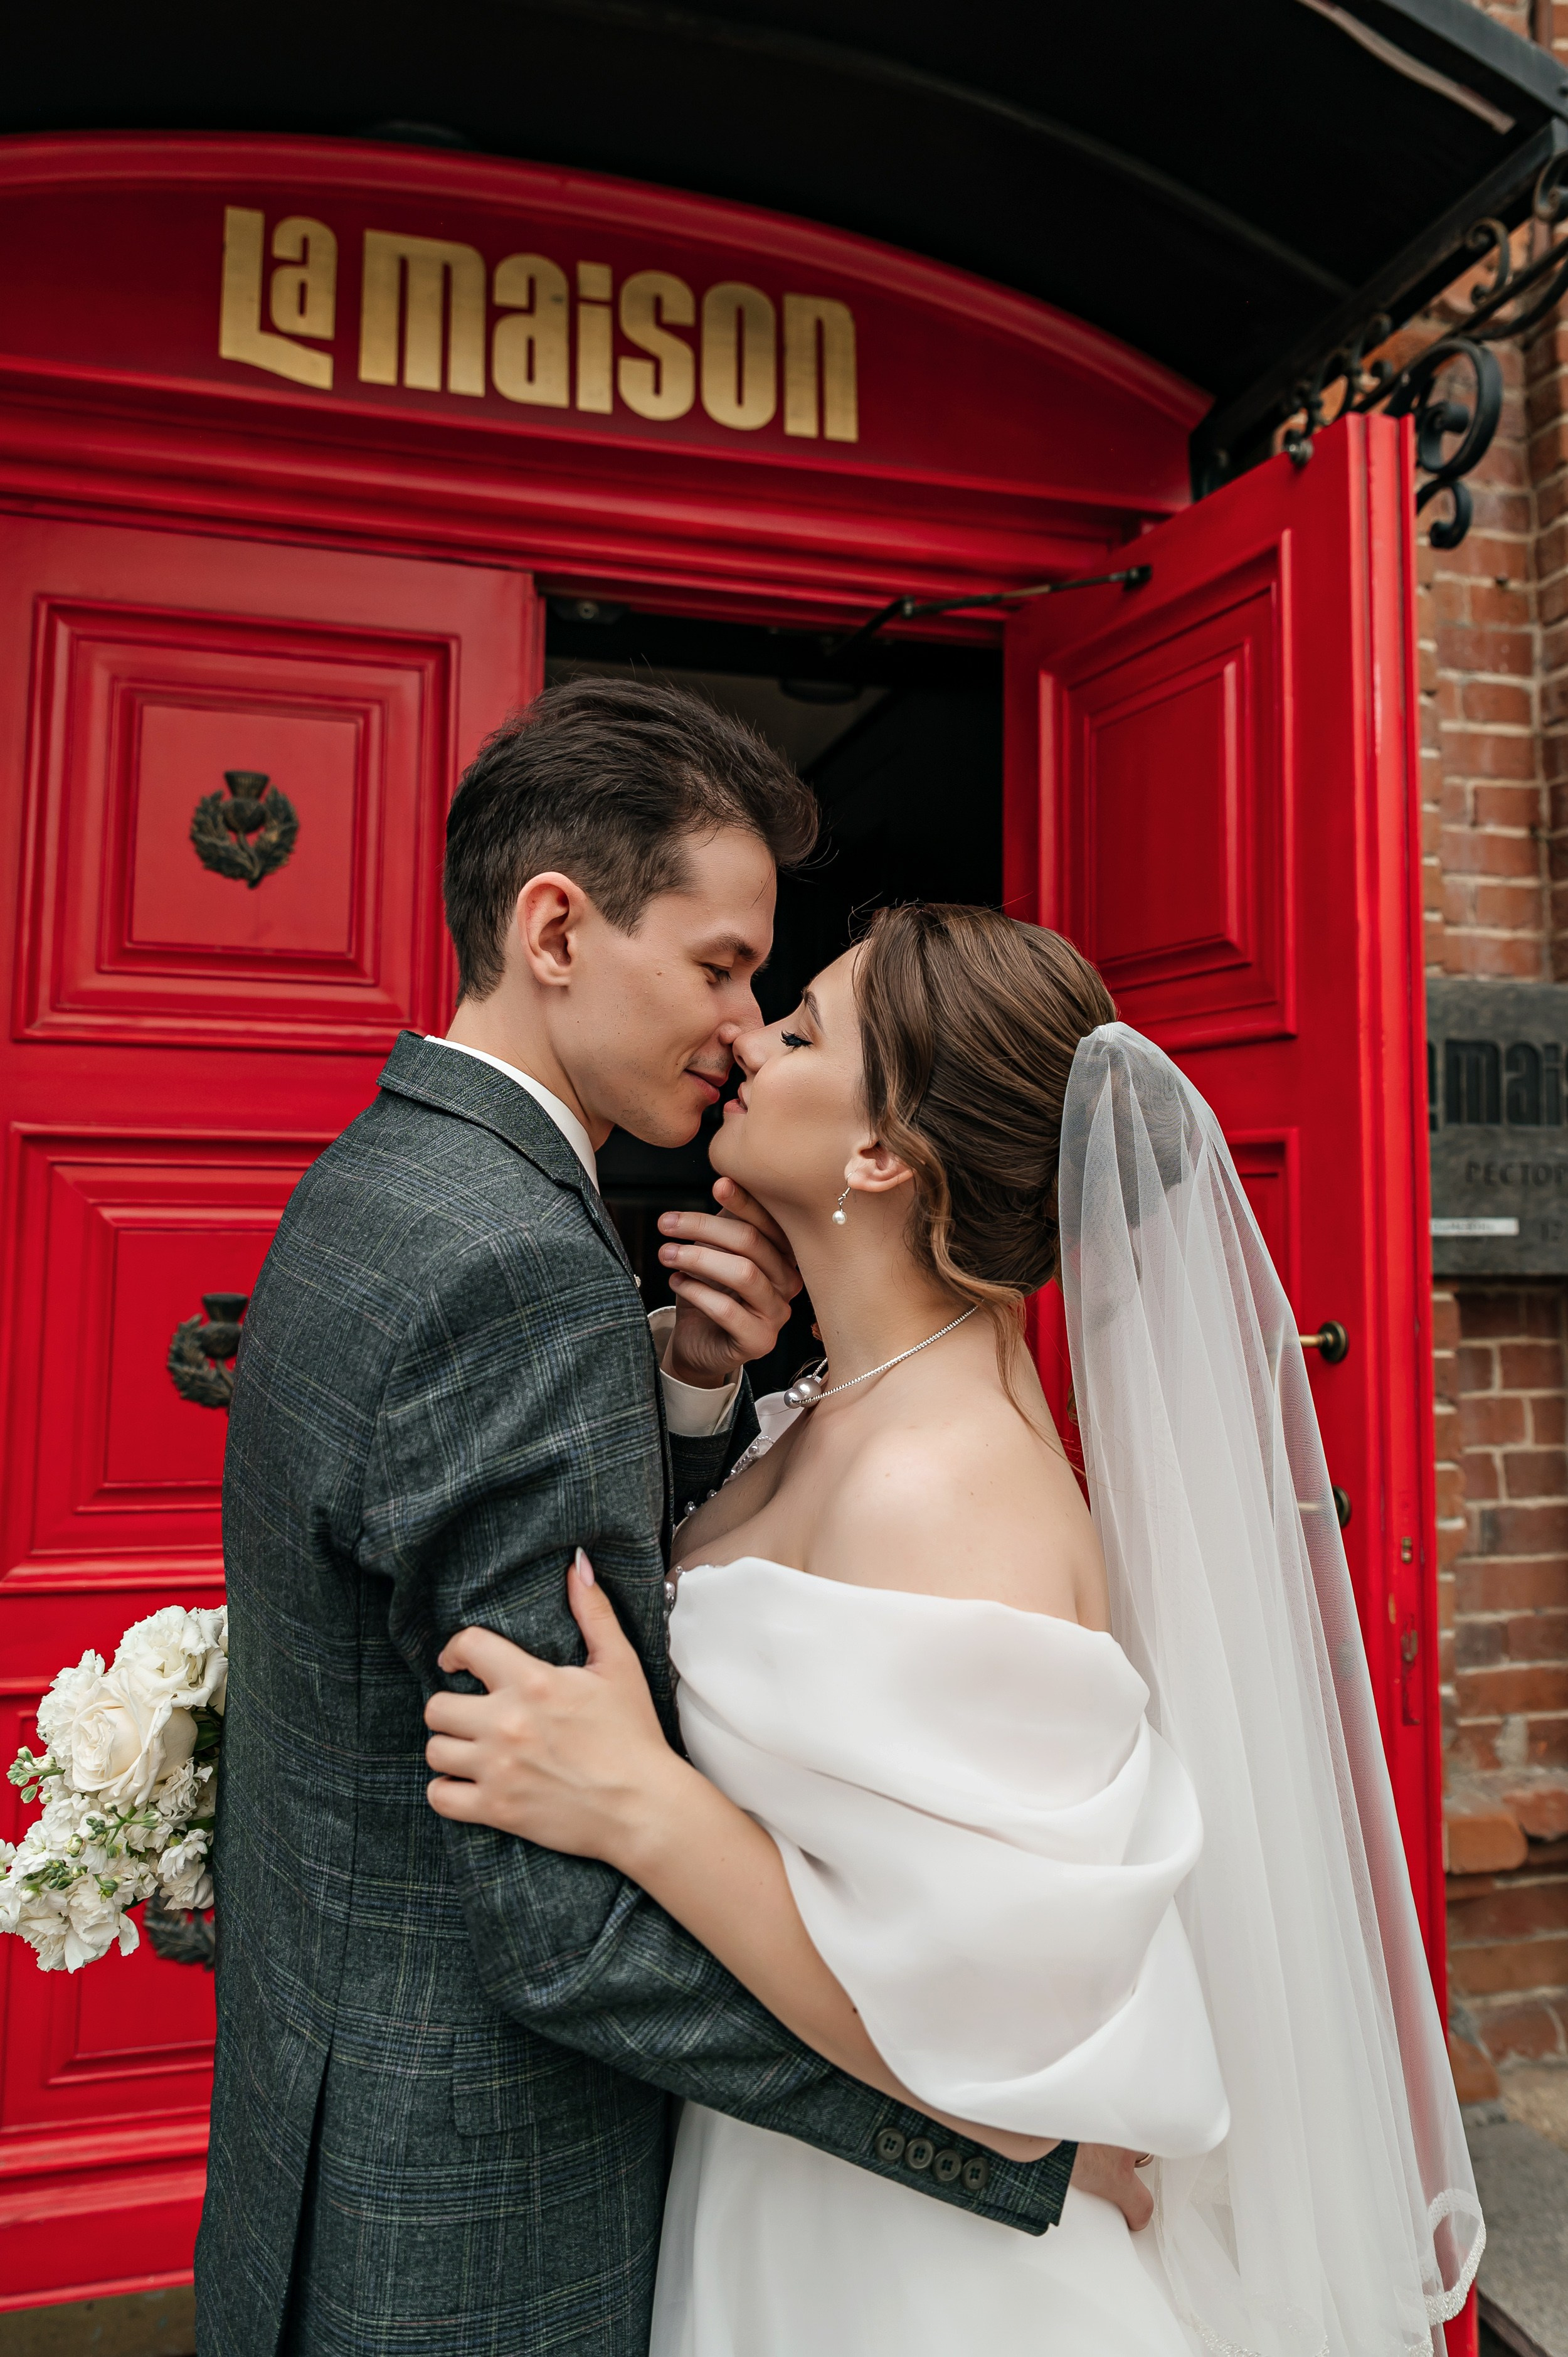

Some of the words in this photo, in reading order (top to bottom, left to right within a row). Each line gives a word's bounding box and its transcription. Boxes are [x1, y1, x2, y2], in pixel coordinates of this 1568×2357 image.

[219, 206, 337, 390] La
[358, 228, 858, 443] maison
[1445, 1039, 1568, 1125] mai
